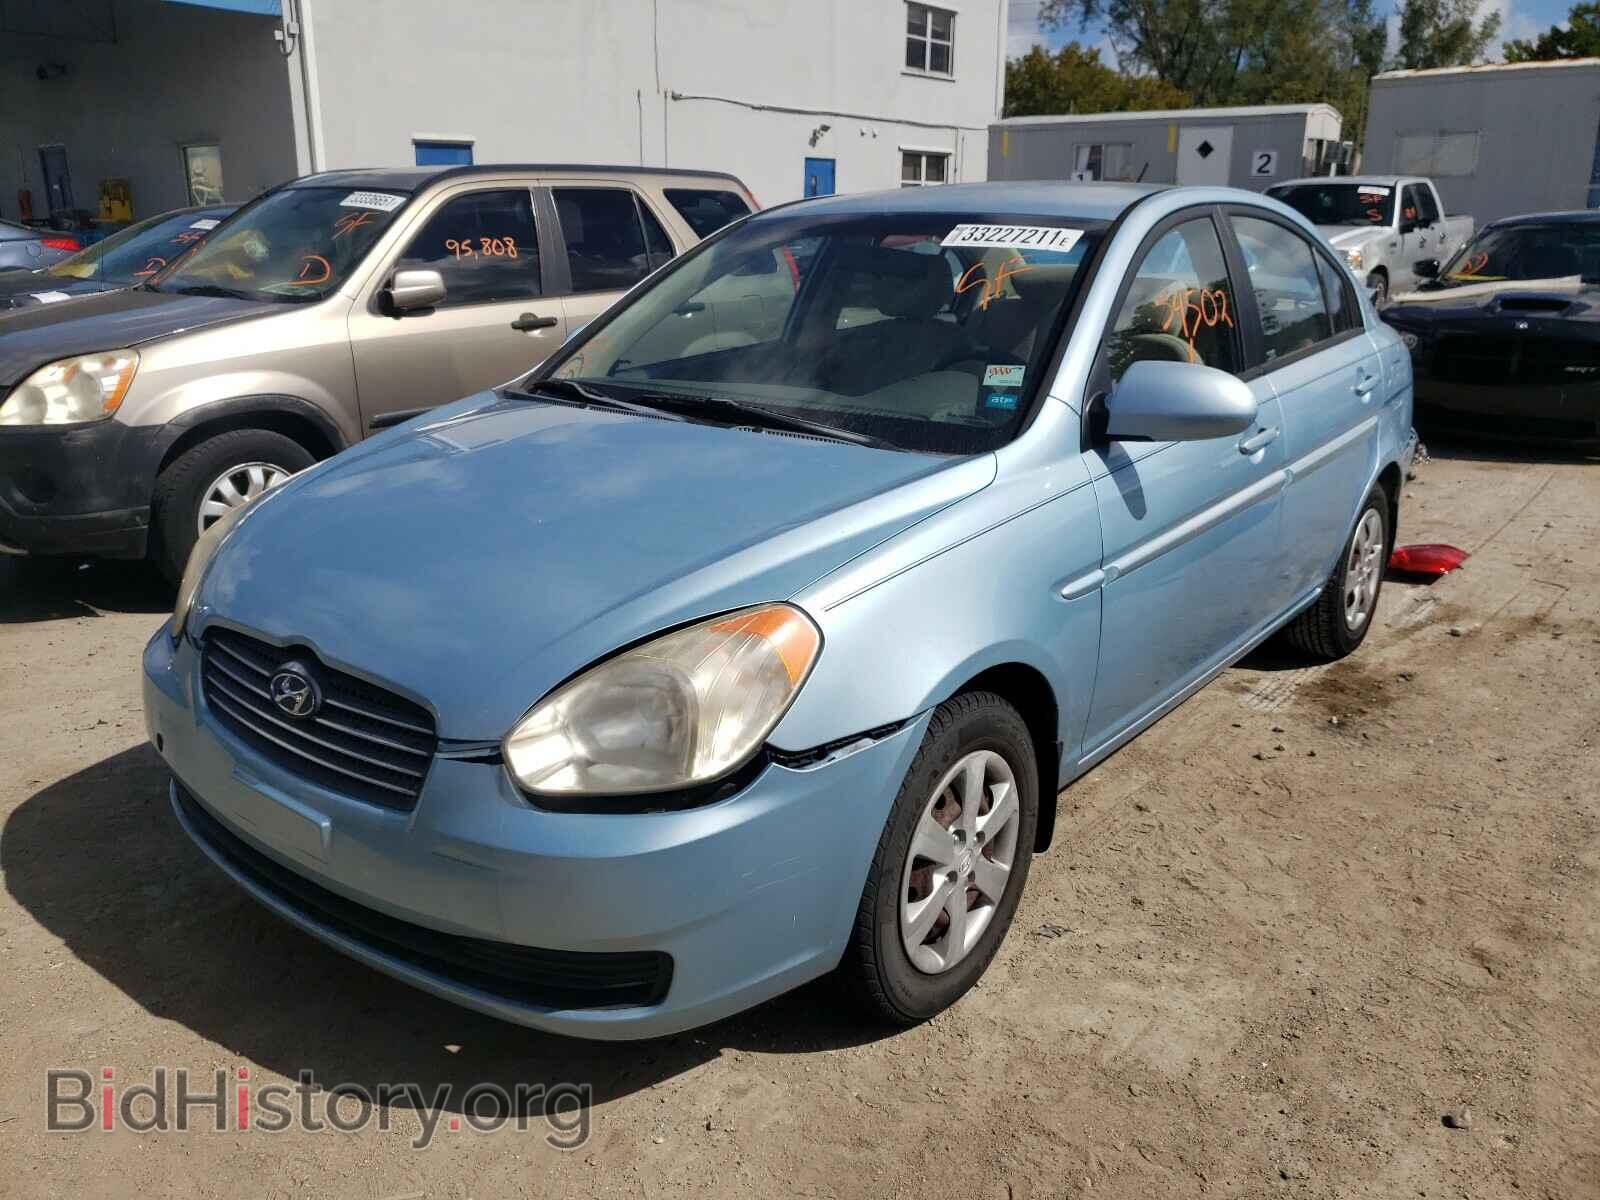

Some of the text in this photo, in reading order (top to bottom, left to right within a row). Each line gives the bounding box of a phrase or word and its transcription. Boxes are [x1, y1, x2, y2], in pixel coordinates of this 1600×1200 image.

[1257, 153, 1272, 174] 2
[445, 236, 518, 265] 95,808
[288, 255, 331, 286] D
